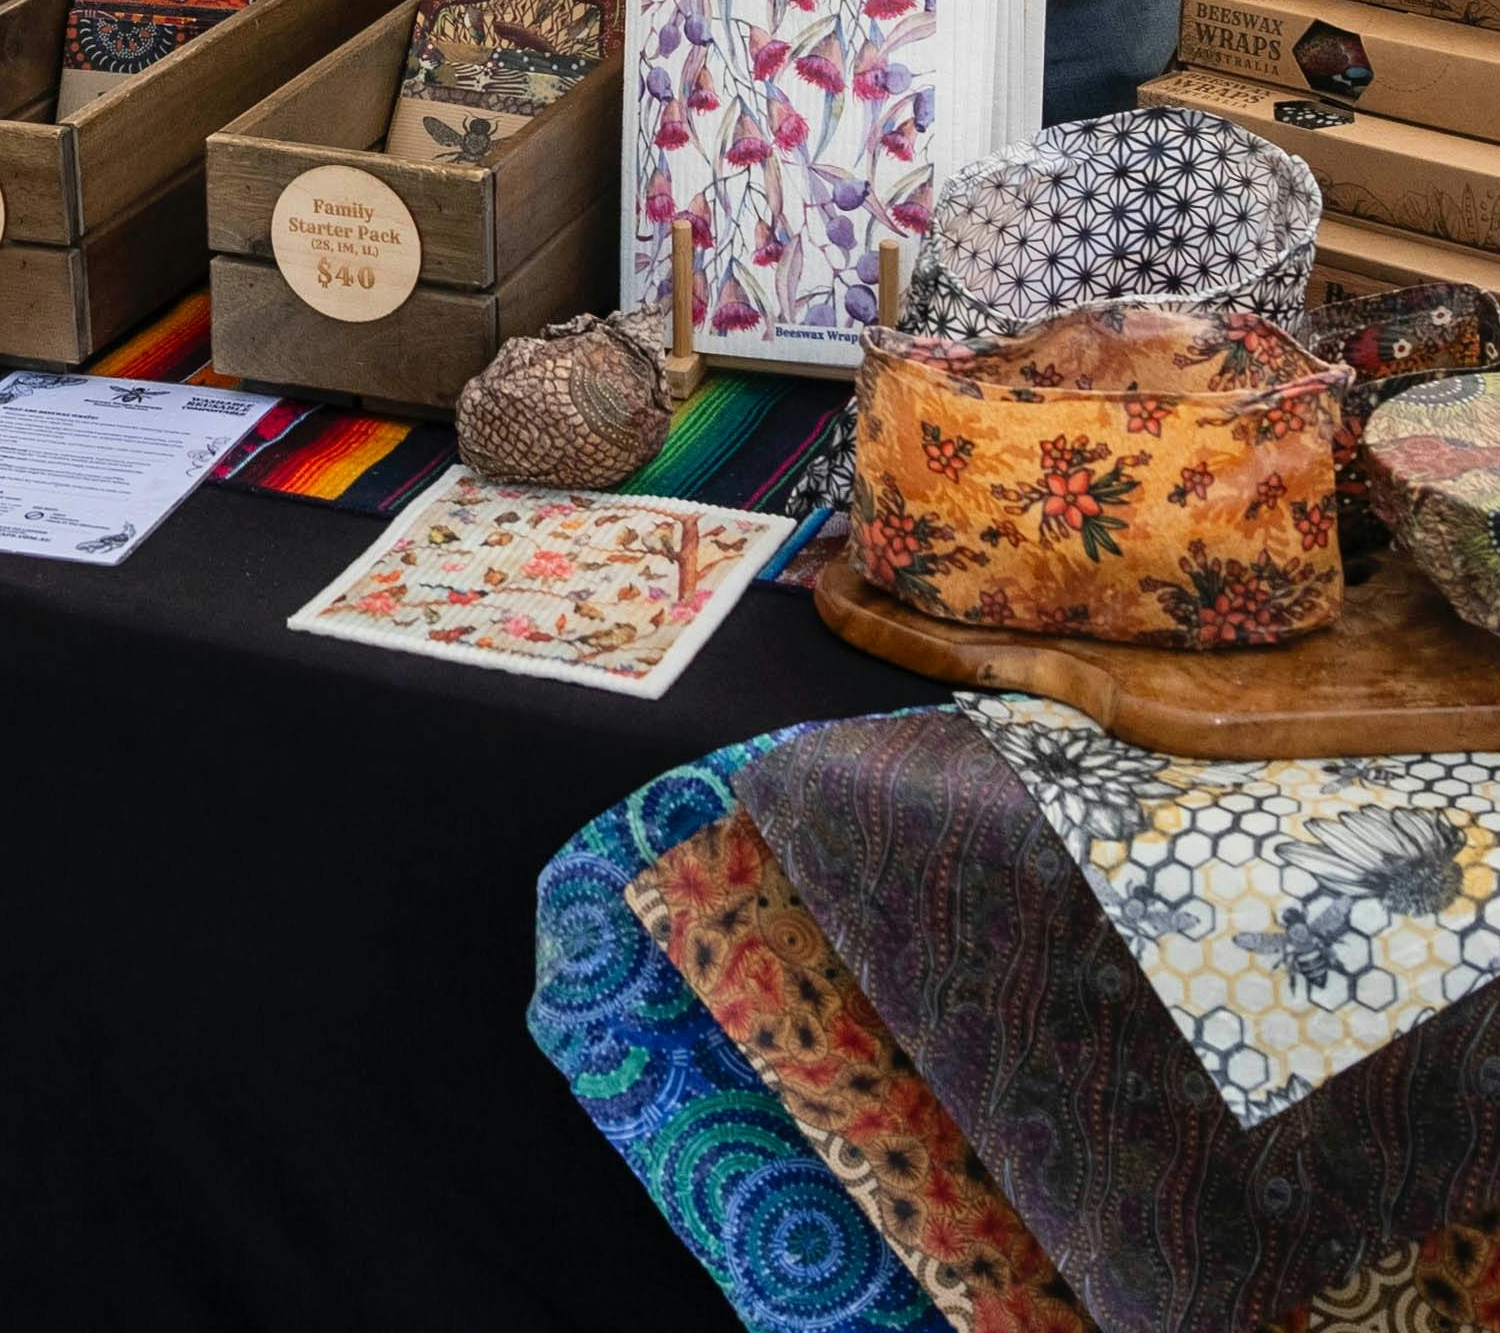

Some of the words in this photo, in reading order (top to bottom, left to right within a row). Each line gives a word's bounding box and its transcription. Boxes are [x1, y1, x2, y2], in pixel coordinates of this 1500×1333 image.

[1196, 2, 1284, 36] BEESWAX
[1195, 22, 1281, 61] WRAPS
[1192, 47, 1280, 76] AUSTRALIA
[1174, 78, 1265, 104] WRAPS
[313, 198, 375, 223] Family
[288, 217, 353, 239] Starter
[358, 225, 402, 245] Pack
[312, 239, 334, 252] (2S,
[317, 257, 376, 289] $40
[776, 327, 824, 341] Beeswax
